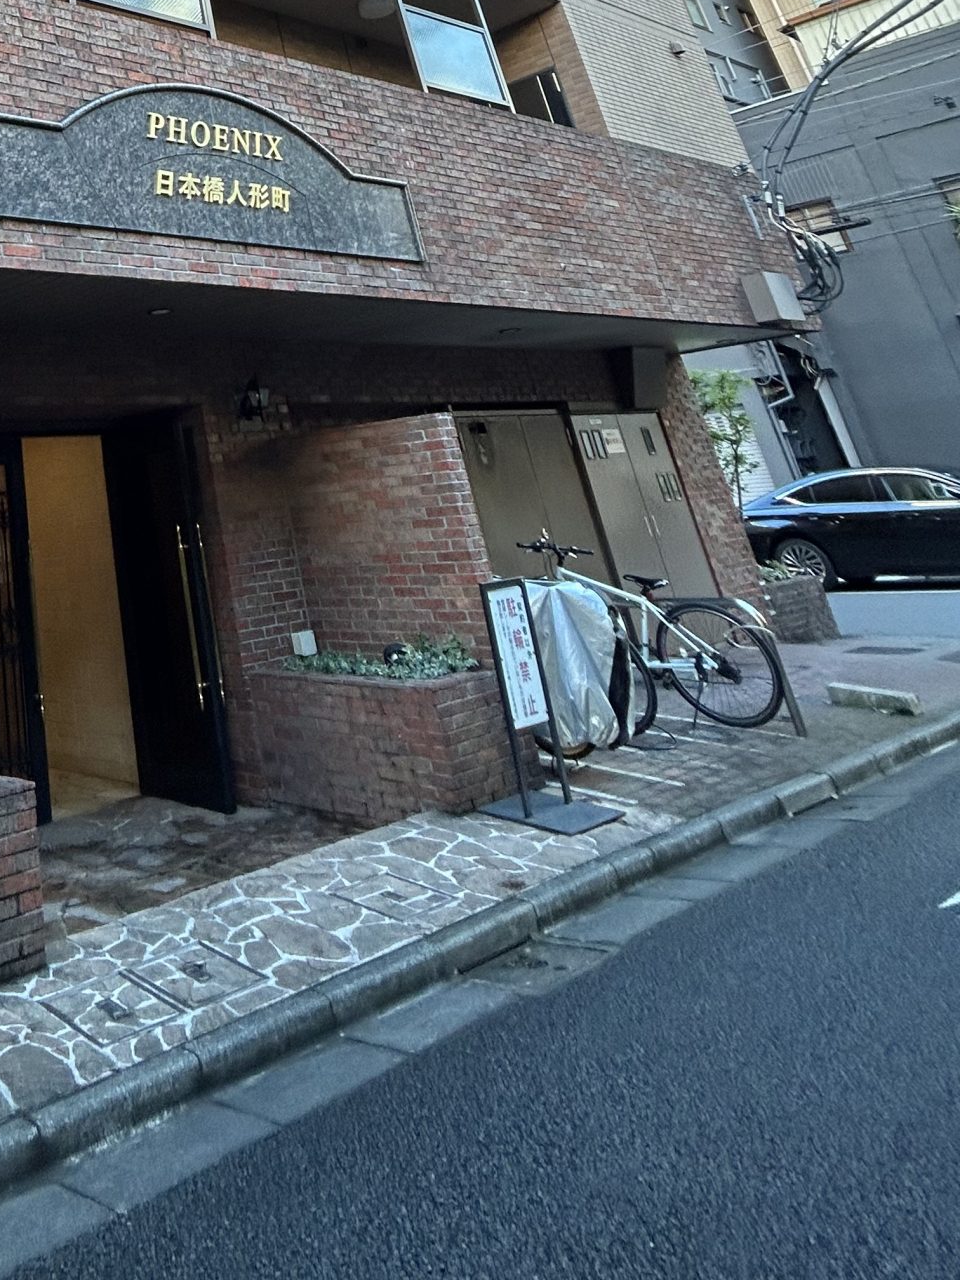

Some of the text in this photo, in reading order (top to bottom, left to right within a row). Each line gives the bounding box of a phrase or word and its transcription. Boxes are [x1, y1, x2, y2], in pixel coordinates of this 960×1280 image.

[146, 111, 284, 161] PHOENIX
[156, 169, 291, 212] 日本橋人形町
[506, 597, 539, 716] 駐輪禁止
